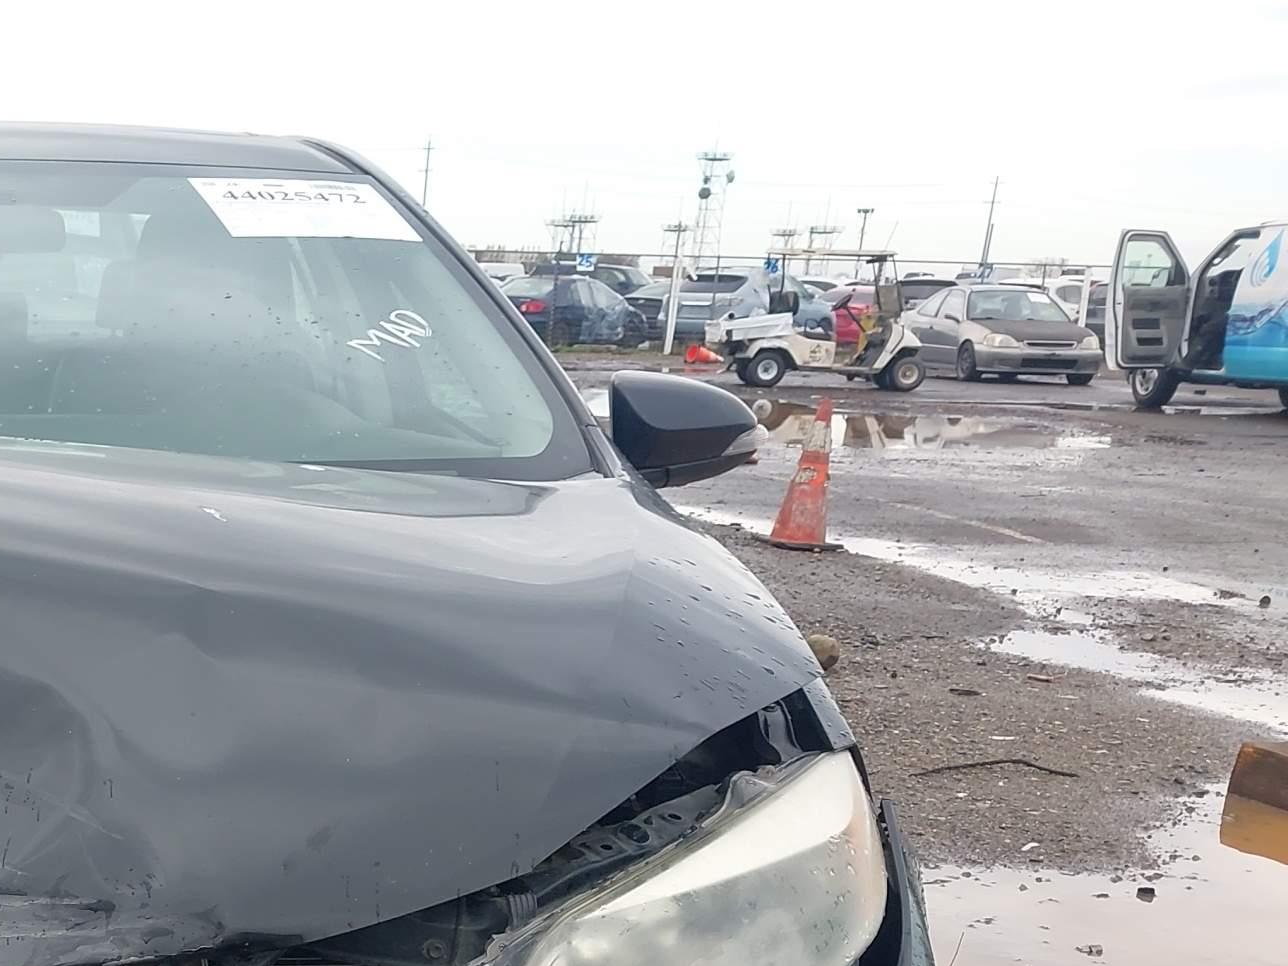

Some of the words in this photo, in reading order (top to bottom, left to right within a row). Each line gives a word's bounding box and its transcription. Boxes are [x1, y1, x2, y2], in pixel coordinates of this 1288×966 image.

[222, 190, 367, 204] 44025472
[578, 255, 593, 268] 25
[346, 309, 432, 362] MAD
